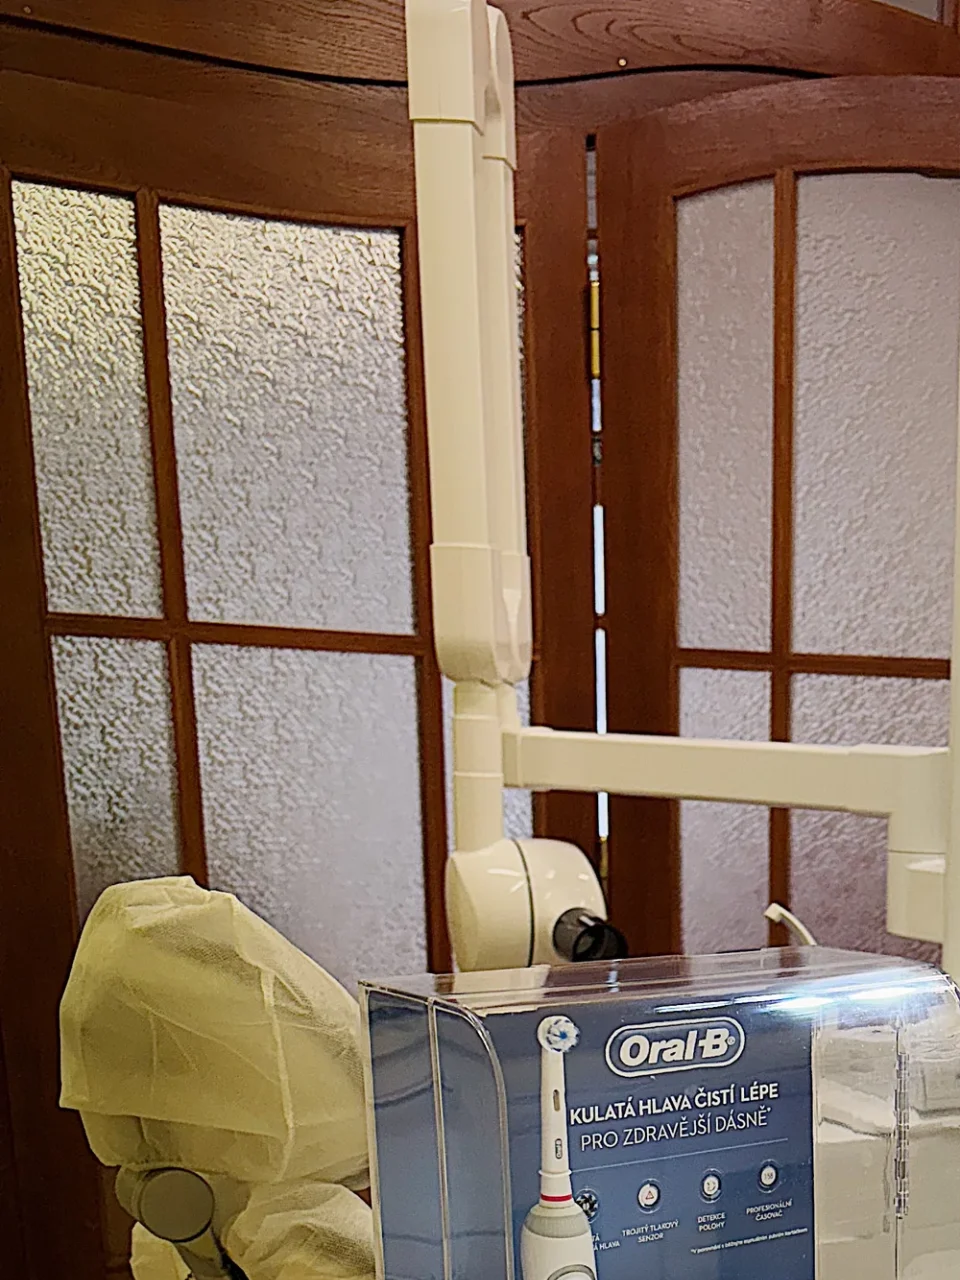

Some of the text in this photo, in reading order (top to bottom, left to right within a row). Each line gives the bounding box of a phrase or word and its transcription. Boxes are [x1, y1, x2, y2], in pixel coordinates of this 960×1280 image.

[619, 1027, 729, 1067] Oral-B
[569, 1081, 779, 1125] KULATÁ HLAVA ČISTÍ LÉPE
[581, 1130, 618, 1151] PRO
[622, 1112, 712, 1147] ZDRAVĚJŠÍ
[697, 1212, 726, 1224] DETEKCE
[621, 1223, 649, 1237] TROJITÝ
[698, 1221, 726, 1232] POLOHY
[637, 1231, 664, 1243] SENZOR
[599, 1240, 620, 1251] HLAVA
